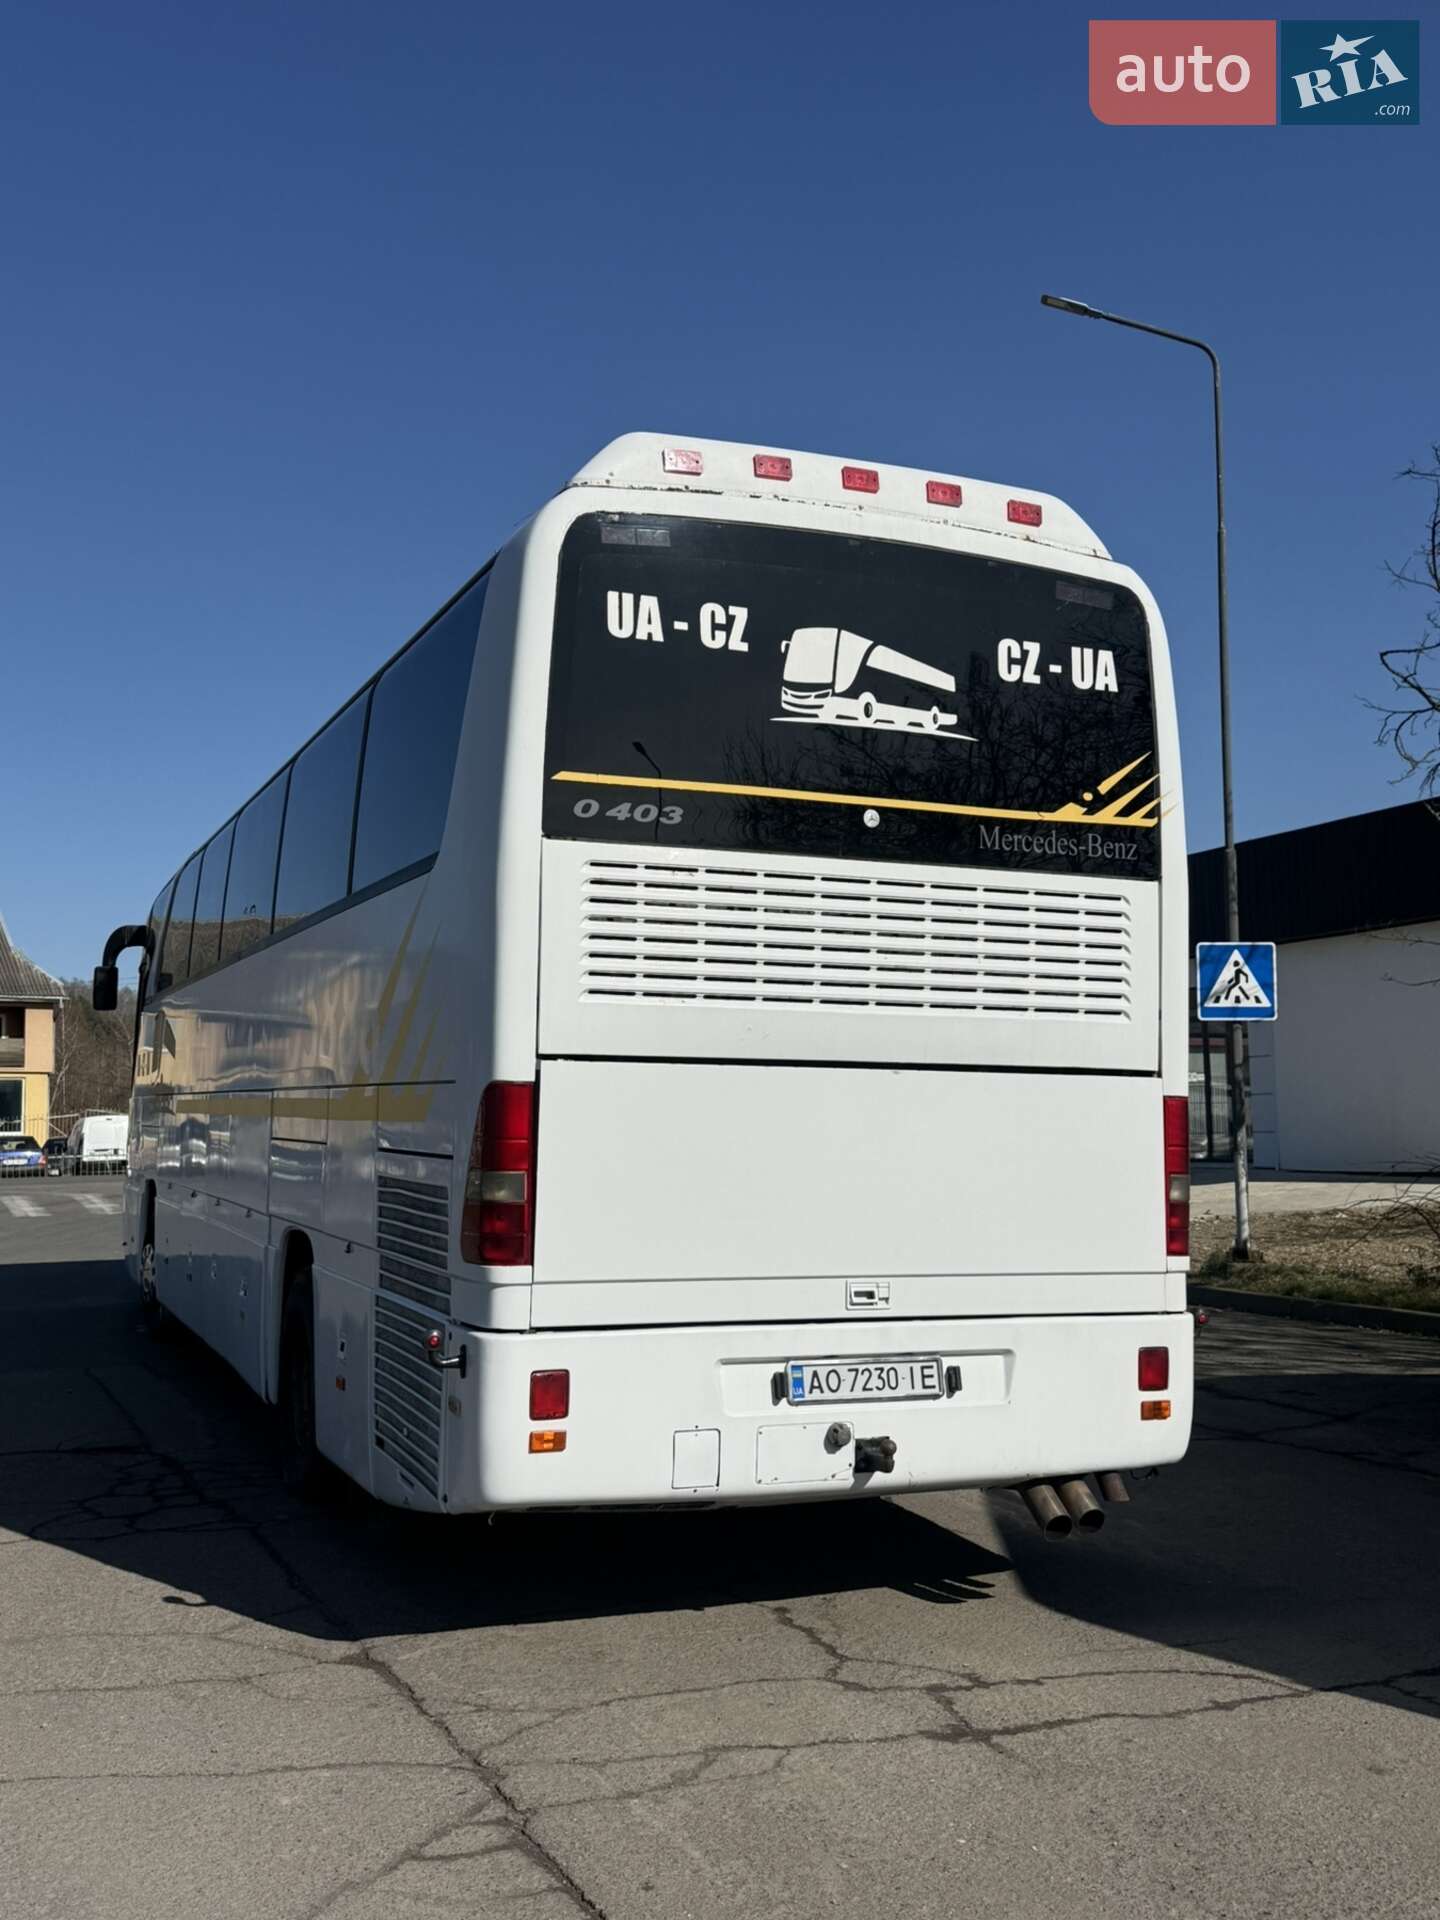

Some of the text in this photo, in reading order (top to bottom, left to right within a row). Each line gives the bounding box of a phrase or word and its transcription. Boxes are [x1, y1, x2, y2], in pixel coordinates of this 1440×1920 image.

[607, 590, 664, 642] UA
[700, 602, 749, 652] CZ
[997, 638, 1041, 684] CZ
[1071, 646, 1119, 693] UA
[605, 802, 684, 825] 403
[979, 825, 1138, 860] Mercedes-Benz
[847, 1367, 899, 1393] 7230
